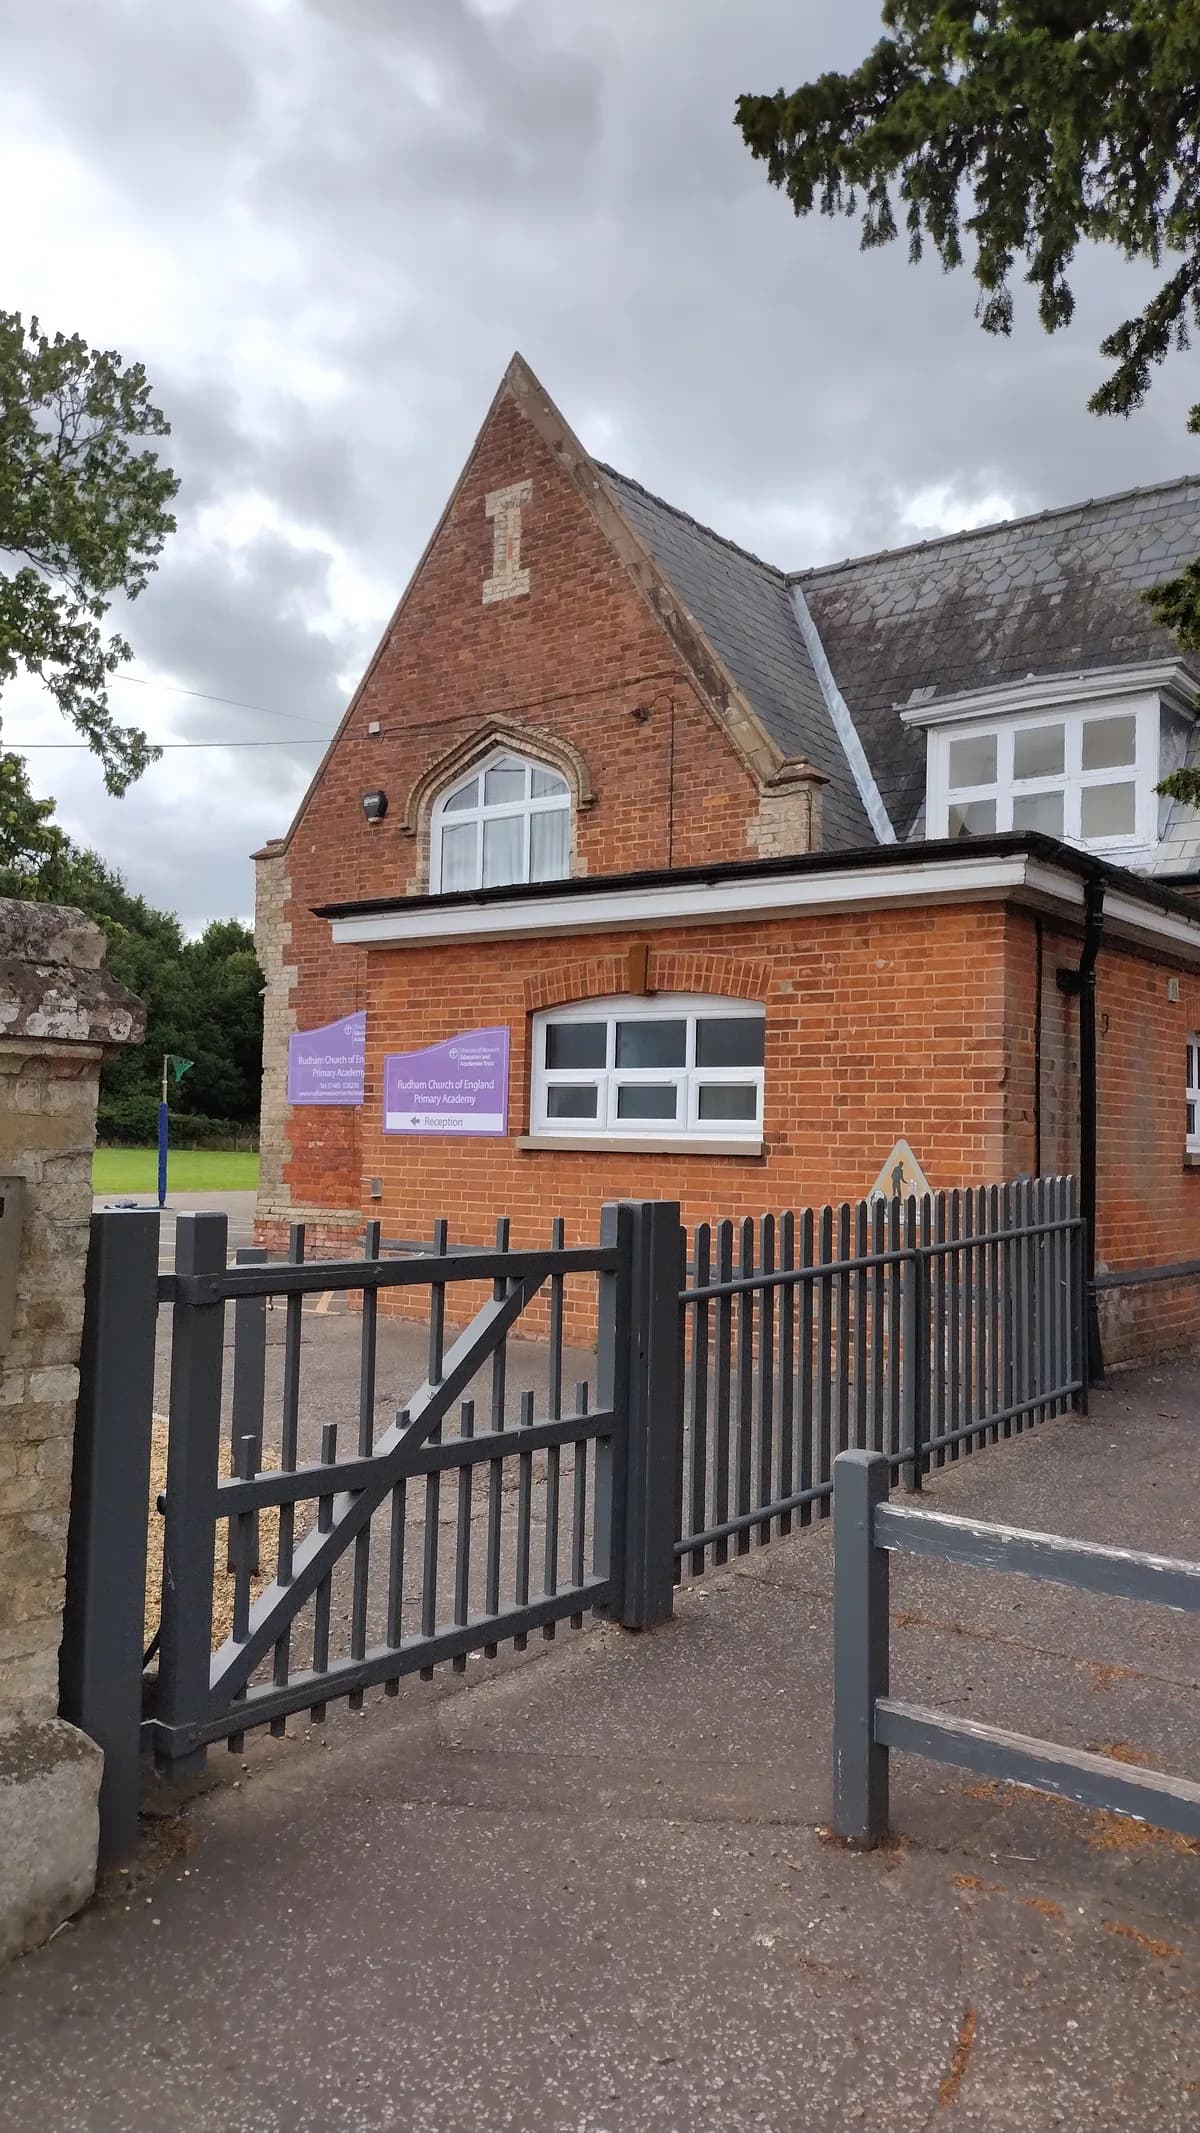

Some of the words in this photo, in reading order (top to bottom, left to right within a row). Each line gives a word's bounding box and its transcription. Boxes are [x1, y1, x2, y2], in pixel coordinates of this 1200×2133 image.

[298, 1056, 324, 1065] Rudham
[324, 1055, 347, 1064] Church
[348, 1055, 355, 1064] of
[312, 1068, 336, 1079] Primary
[397, 1079, 427, 1090] Rudham
[428, 1079, 454, 1090] Church
[455, 1079, 463, 1090] of
[464, 1079, 495, 1092] England
[414, 1094, 441, 1106] Primary
[442, 1094, 476, 1106] Academy
[424, 1117, 463, 1128] Reception
